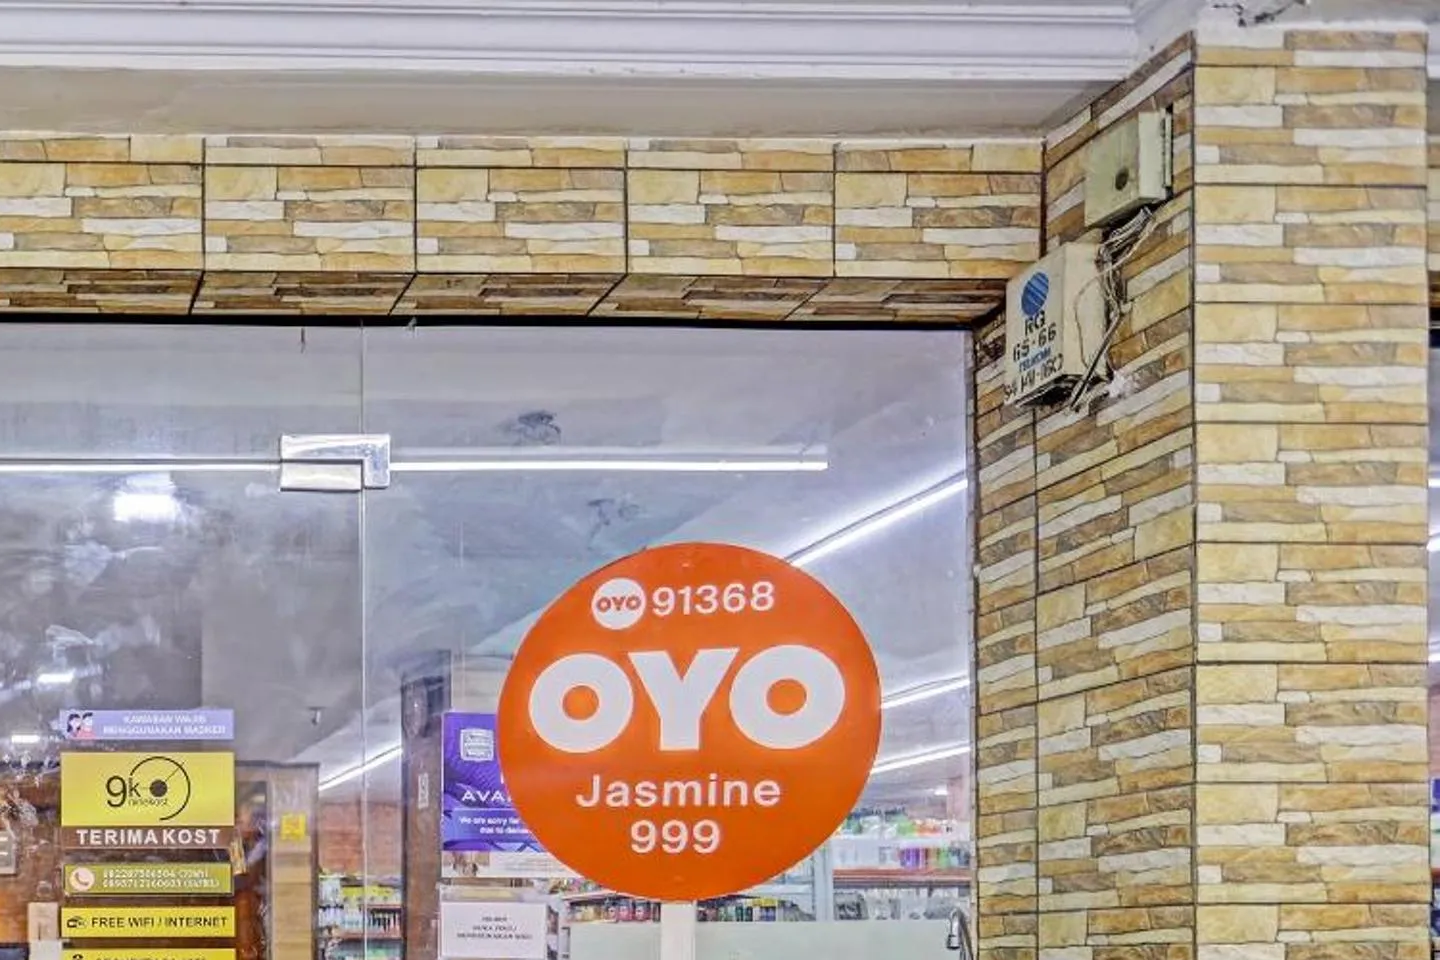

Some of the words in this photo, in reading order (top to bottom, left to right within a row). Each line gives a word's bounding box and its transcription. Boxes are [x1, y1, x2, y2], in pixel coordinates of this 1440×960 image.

[596, 595, 642, 613] OYO
[652, 581, 775, 616] 91368
[528, 644, 846, 753] OYO
[462, 790, 512, 802] AVA
[576, 773, 781, 808] Jasmine
[76, 829, 158, 845] TERIMA
[162, 829, 221, 844] KOST
[630, 819, 722, 854] 999
[91, 917, 124, 928] FREE
[128, 917, 155, 928] WIFI
[164, 917, 227, 928] INTERNET
